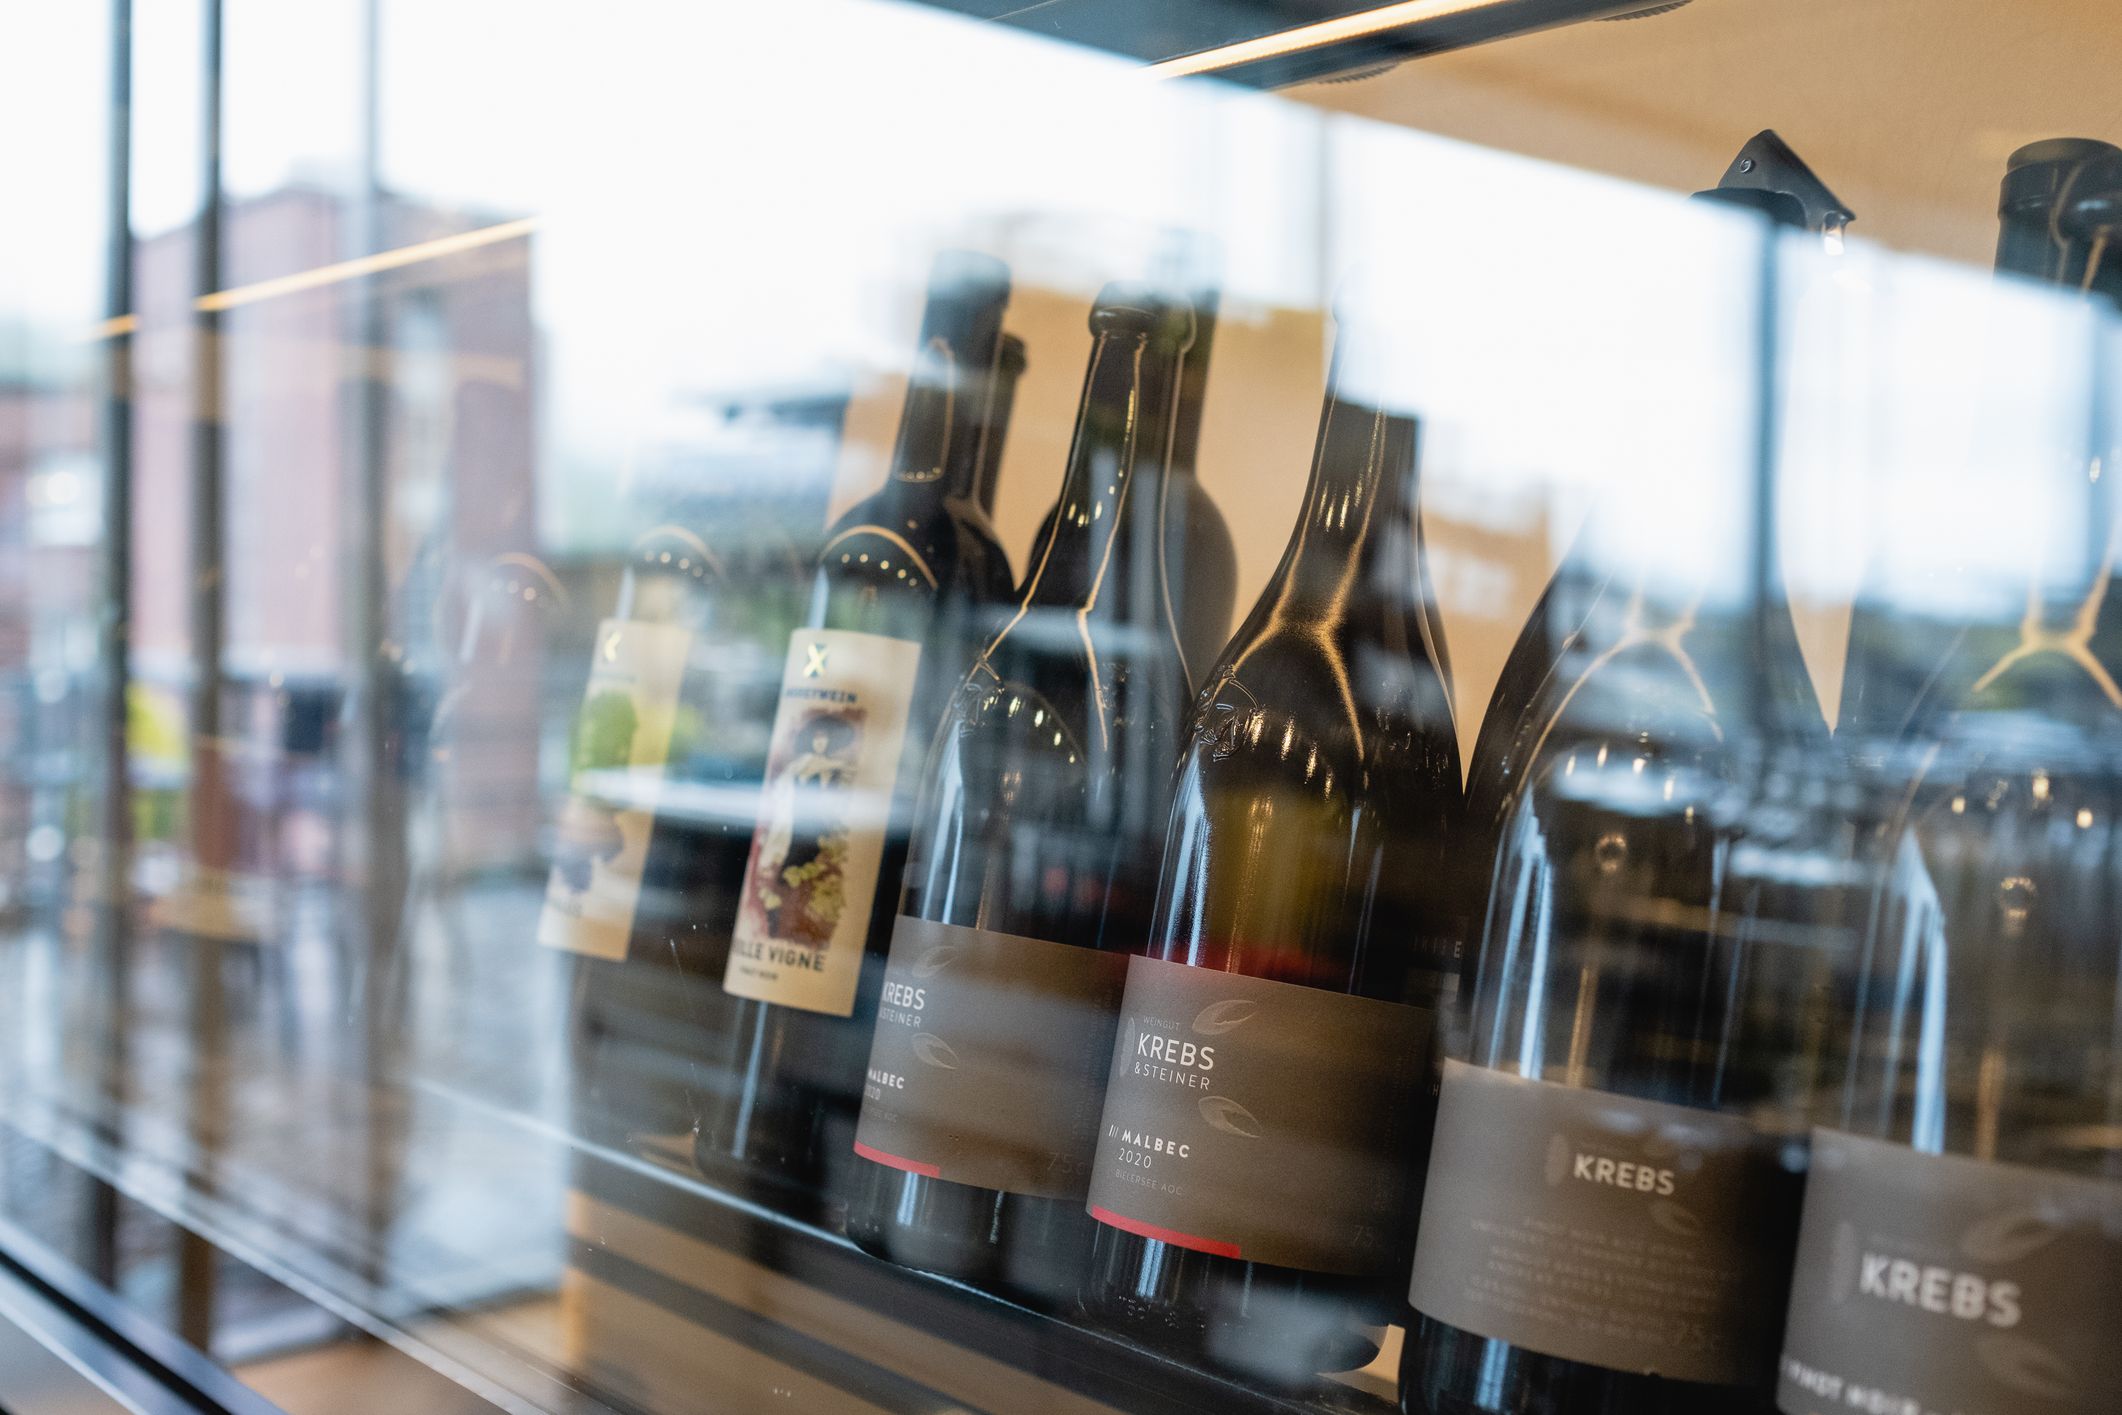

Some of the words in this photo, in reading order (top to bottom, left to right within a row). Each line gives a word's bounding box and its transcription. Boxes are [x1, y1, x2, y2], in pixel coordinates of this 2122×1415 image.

[769, 946, 825, 972] VIGNE
[1143, 1015, 1181, 1031] WEINGUT
[1137, 1032, 1216, 1071] KREBS
[1118, 1147, 1152, 1169] 2020
[1121, 1129, 1191, 1159] MALBEC
[1115, 1168, 1158, 1191] BIELERSEE
[1160, 1183, 1184, 1197] AOC
[1573, 1153, 1675, 1197] KREBS
[1859, 1252, 2022, 1328] KREBS
